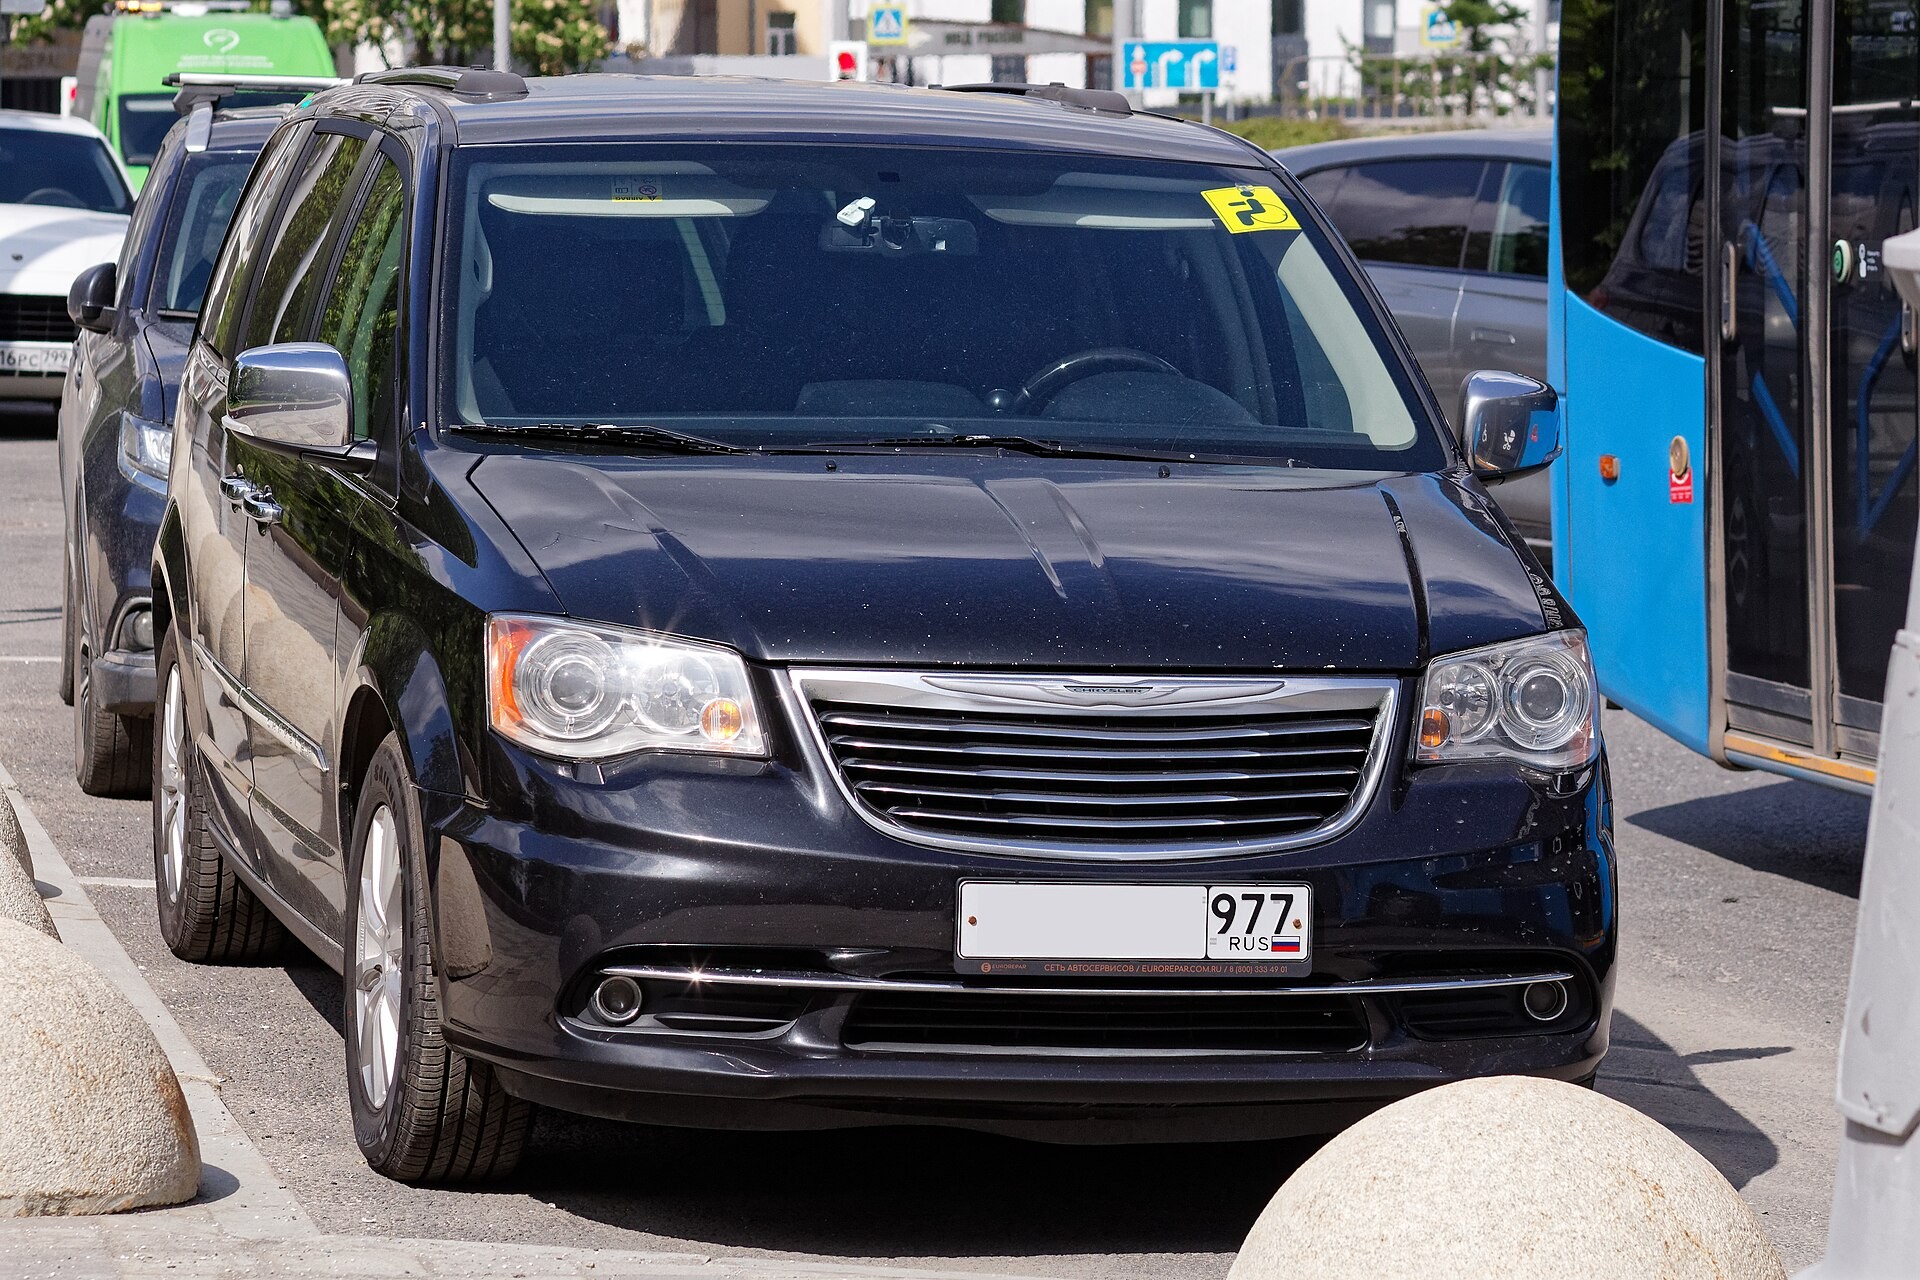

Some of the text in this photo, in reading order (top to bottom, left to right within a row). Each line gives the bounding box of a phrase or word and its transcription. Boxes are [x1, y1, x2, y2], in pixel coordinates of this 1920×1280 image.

[1211, 893, 1294, 935] 977
[1229, 936, 1269, 951] RUS
[1044, 964, 1066, 972] СЕТЬ
[1067, 964, 1134, 973] АВТОСЕРВИСОВ
[1142, 965, 1222, 973] EUROREPAR.COM.RU
[1229, 965, 1234, 973] 8
[1235, 965, 1253, 974] (800)
